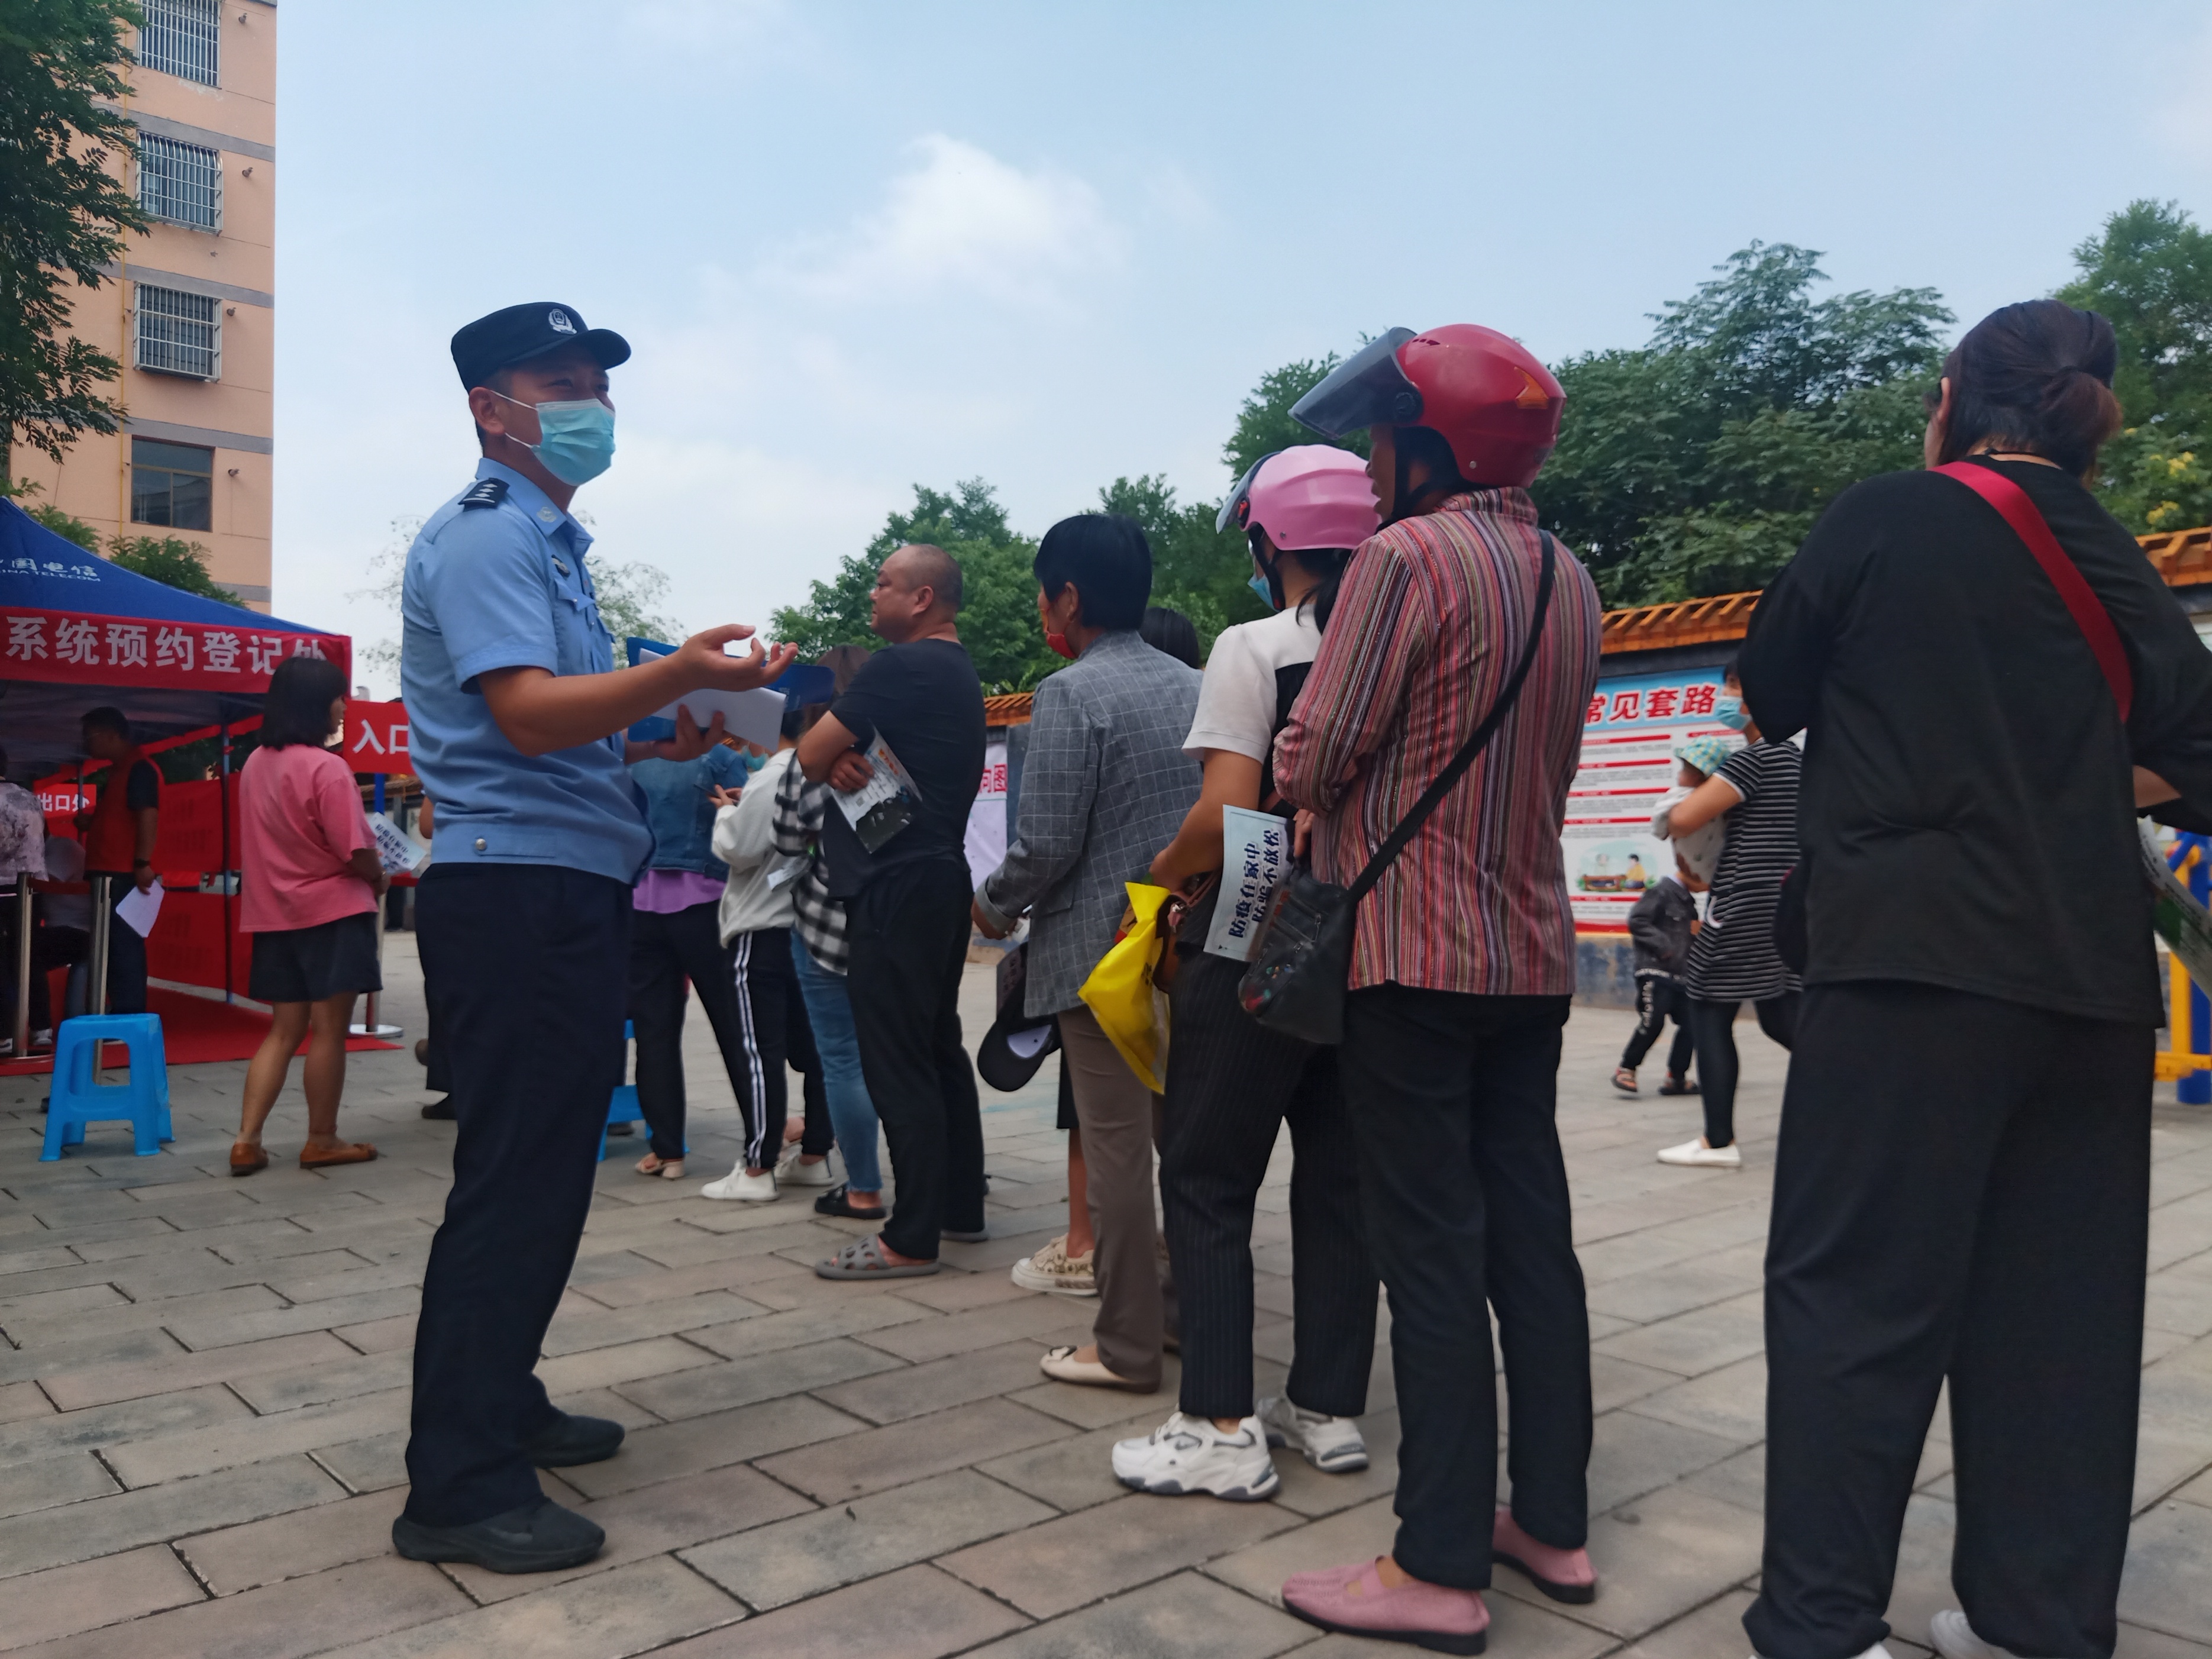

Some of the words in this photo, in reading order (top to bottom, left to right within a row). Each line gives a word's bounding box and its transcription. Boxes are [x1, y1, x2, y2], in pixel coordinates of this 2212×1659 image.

[0, 558, 98, 577] 国电信
[32, 570, 101, 582] TELECOM
[353, 719, 410, 755] 入口
[1228, 843, 1261, 938] 防疫在家中
